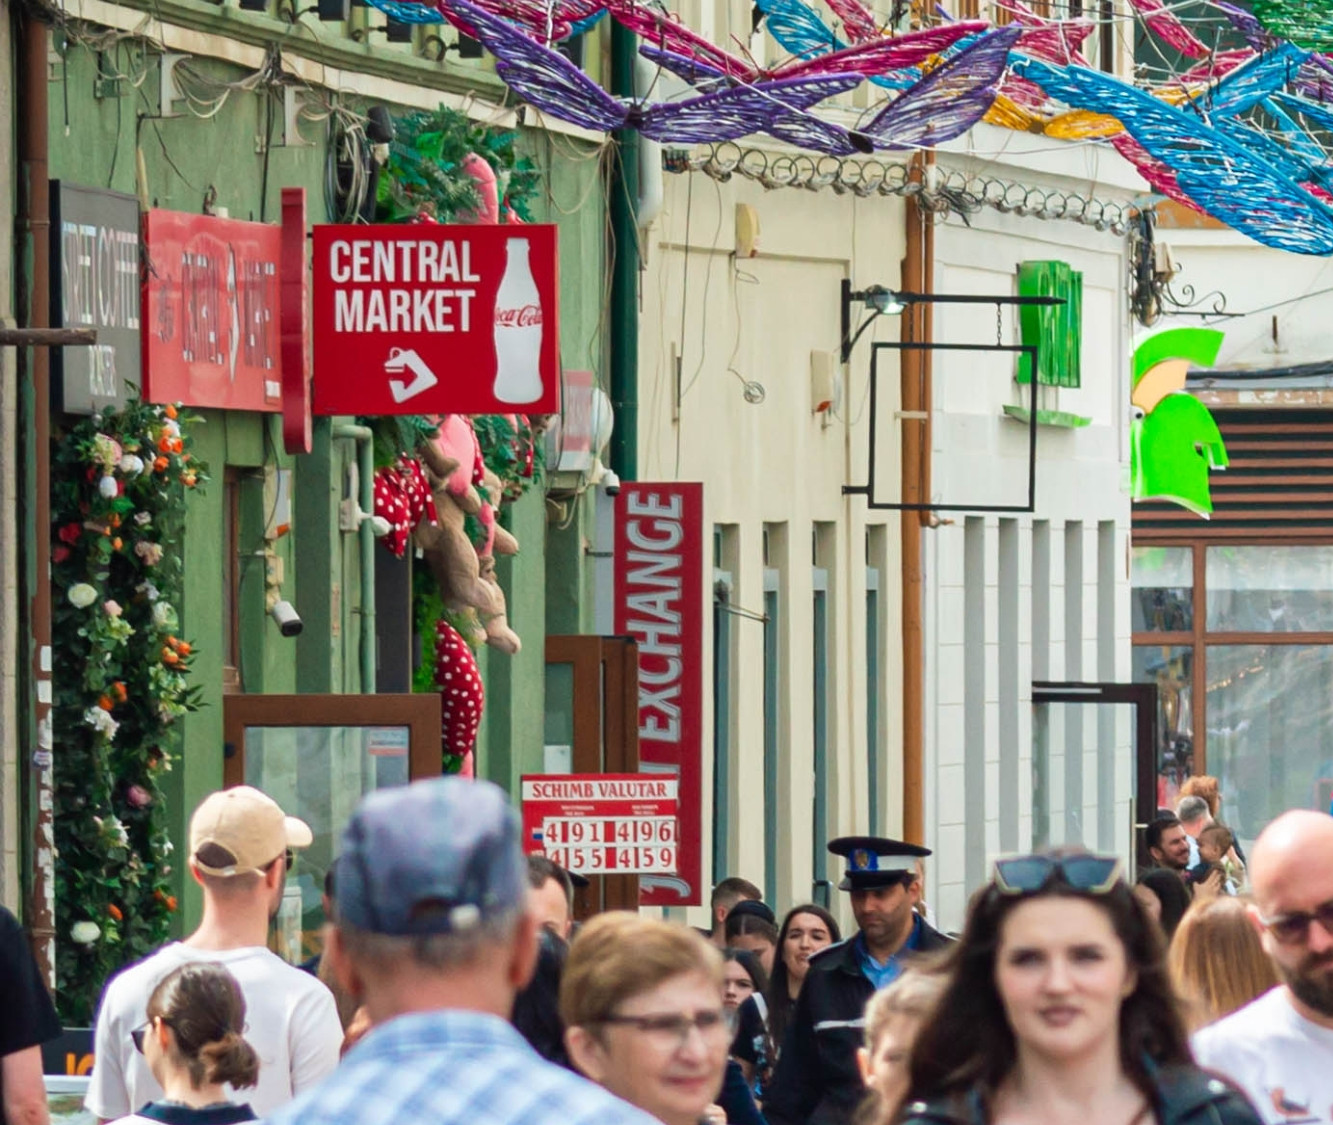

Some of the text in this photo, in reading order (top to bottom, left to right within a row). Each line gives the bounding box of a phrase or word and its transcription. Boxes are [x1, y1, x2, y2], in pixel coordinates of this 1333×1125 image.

[329, 240, 481, 283] CENTRAL
[334, 289, 477, 333] MARKET
[626, 491, 683, 742] EXCHANGE
[532, 782, 668, 798] SCHIMB VALUTAR
